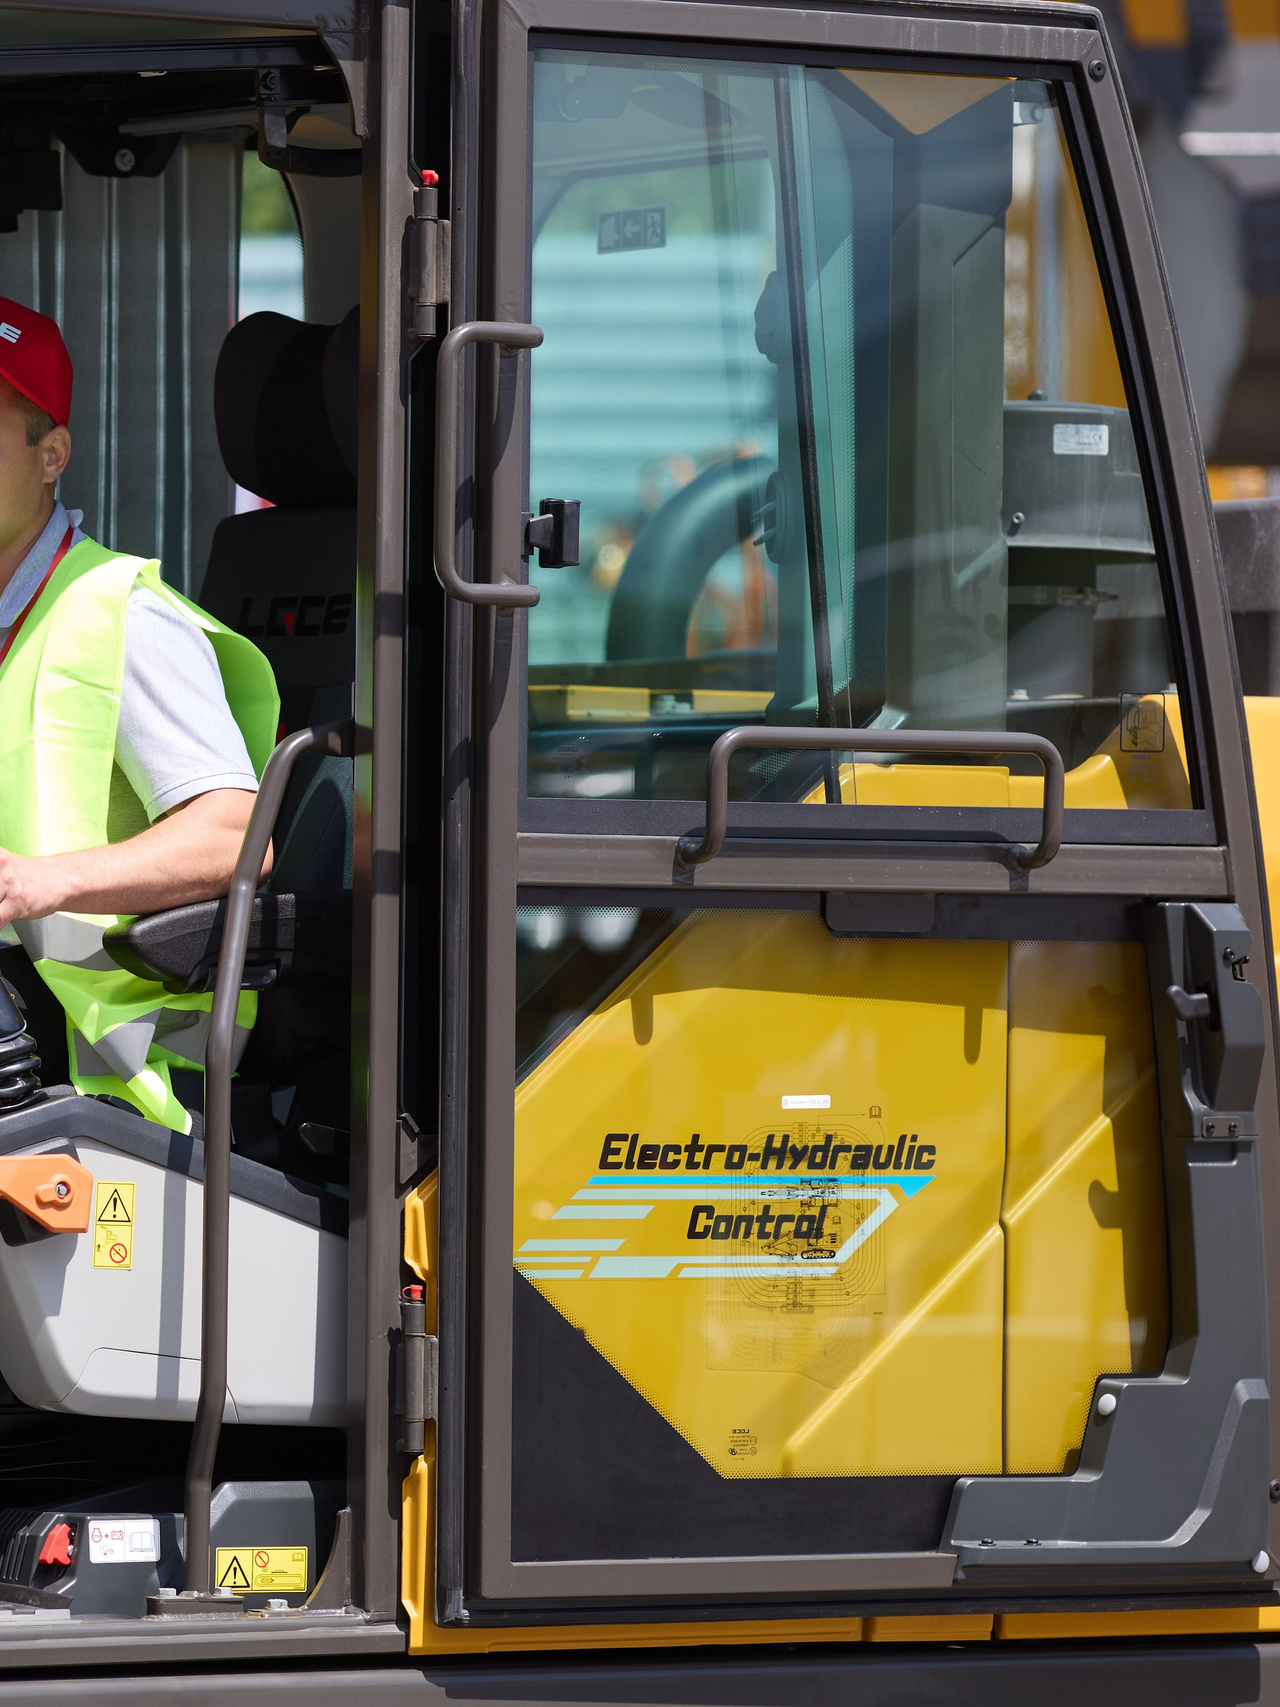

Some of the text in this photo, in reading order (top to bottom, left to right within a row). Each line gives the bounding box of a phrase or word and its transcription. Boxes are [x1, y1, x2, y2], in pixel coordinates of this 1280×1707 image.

[238, 593, 353, 637] LGCE
[598, 1133, 936, 1170] Electro-Hydraulic
[686, 1205, 826, 1240] Control
